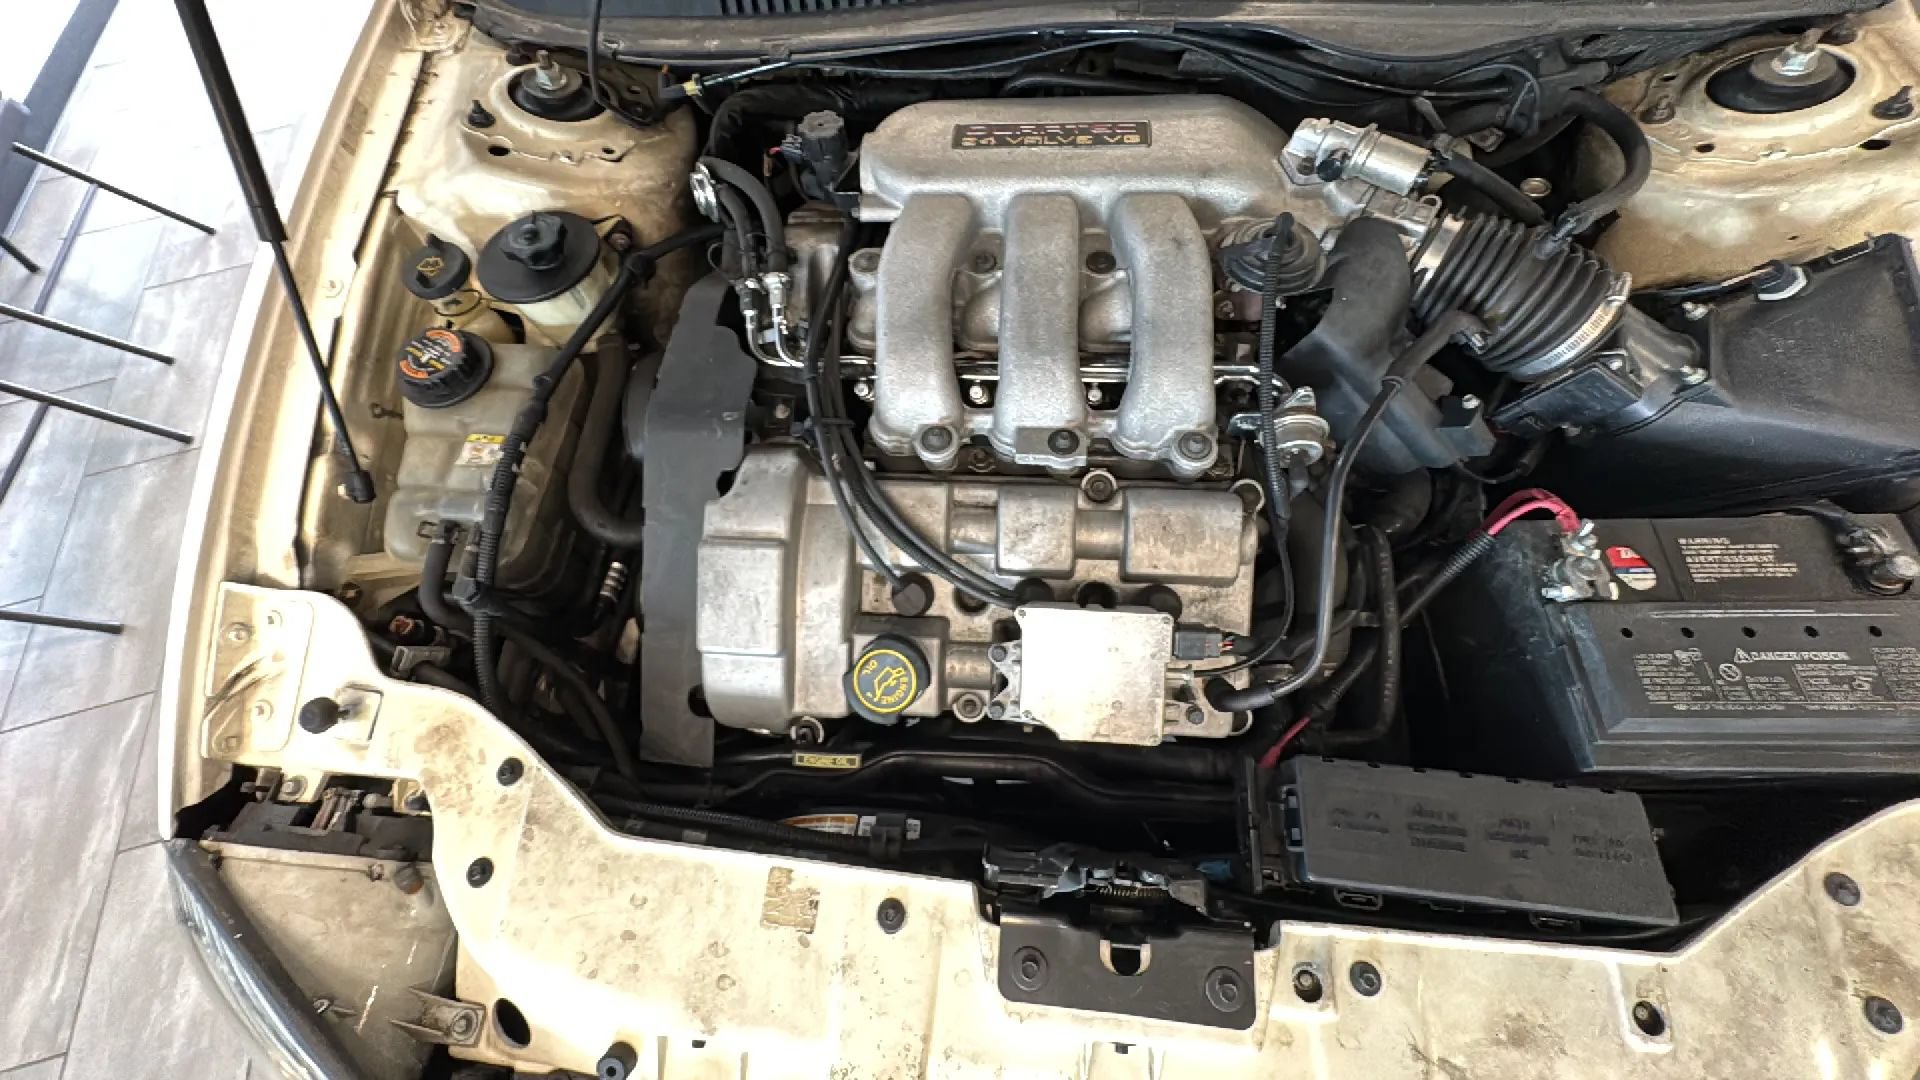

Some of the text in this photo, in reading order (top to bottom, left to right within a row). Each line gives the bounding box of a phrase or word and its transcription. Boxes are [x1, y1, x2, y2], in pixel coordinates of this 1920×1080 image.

[1005, 134, 1094, 146] VALVE
[1678, 537, 1731, 545] WARNING
[1685, 555, 1775, 563] AVERTISSEMENT
[861, 659, 910, 705] ENGINE OIL
